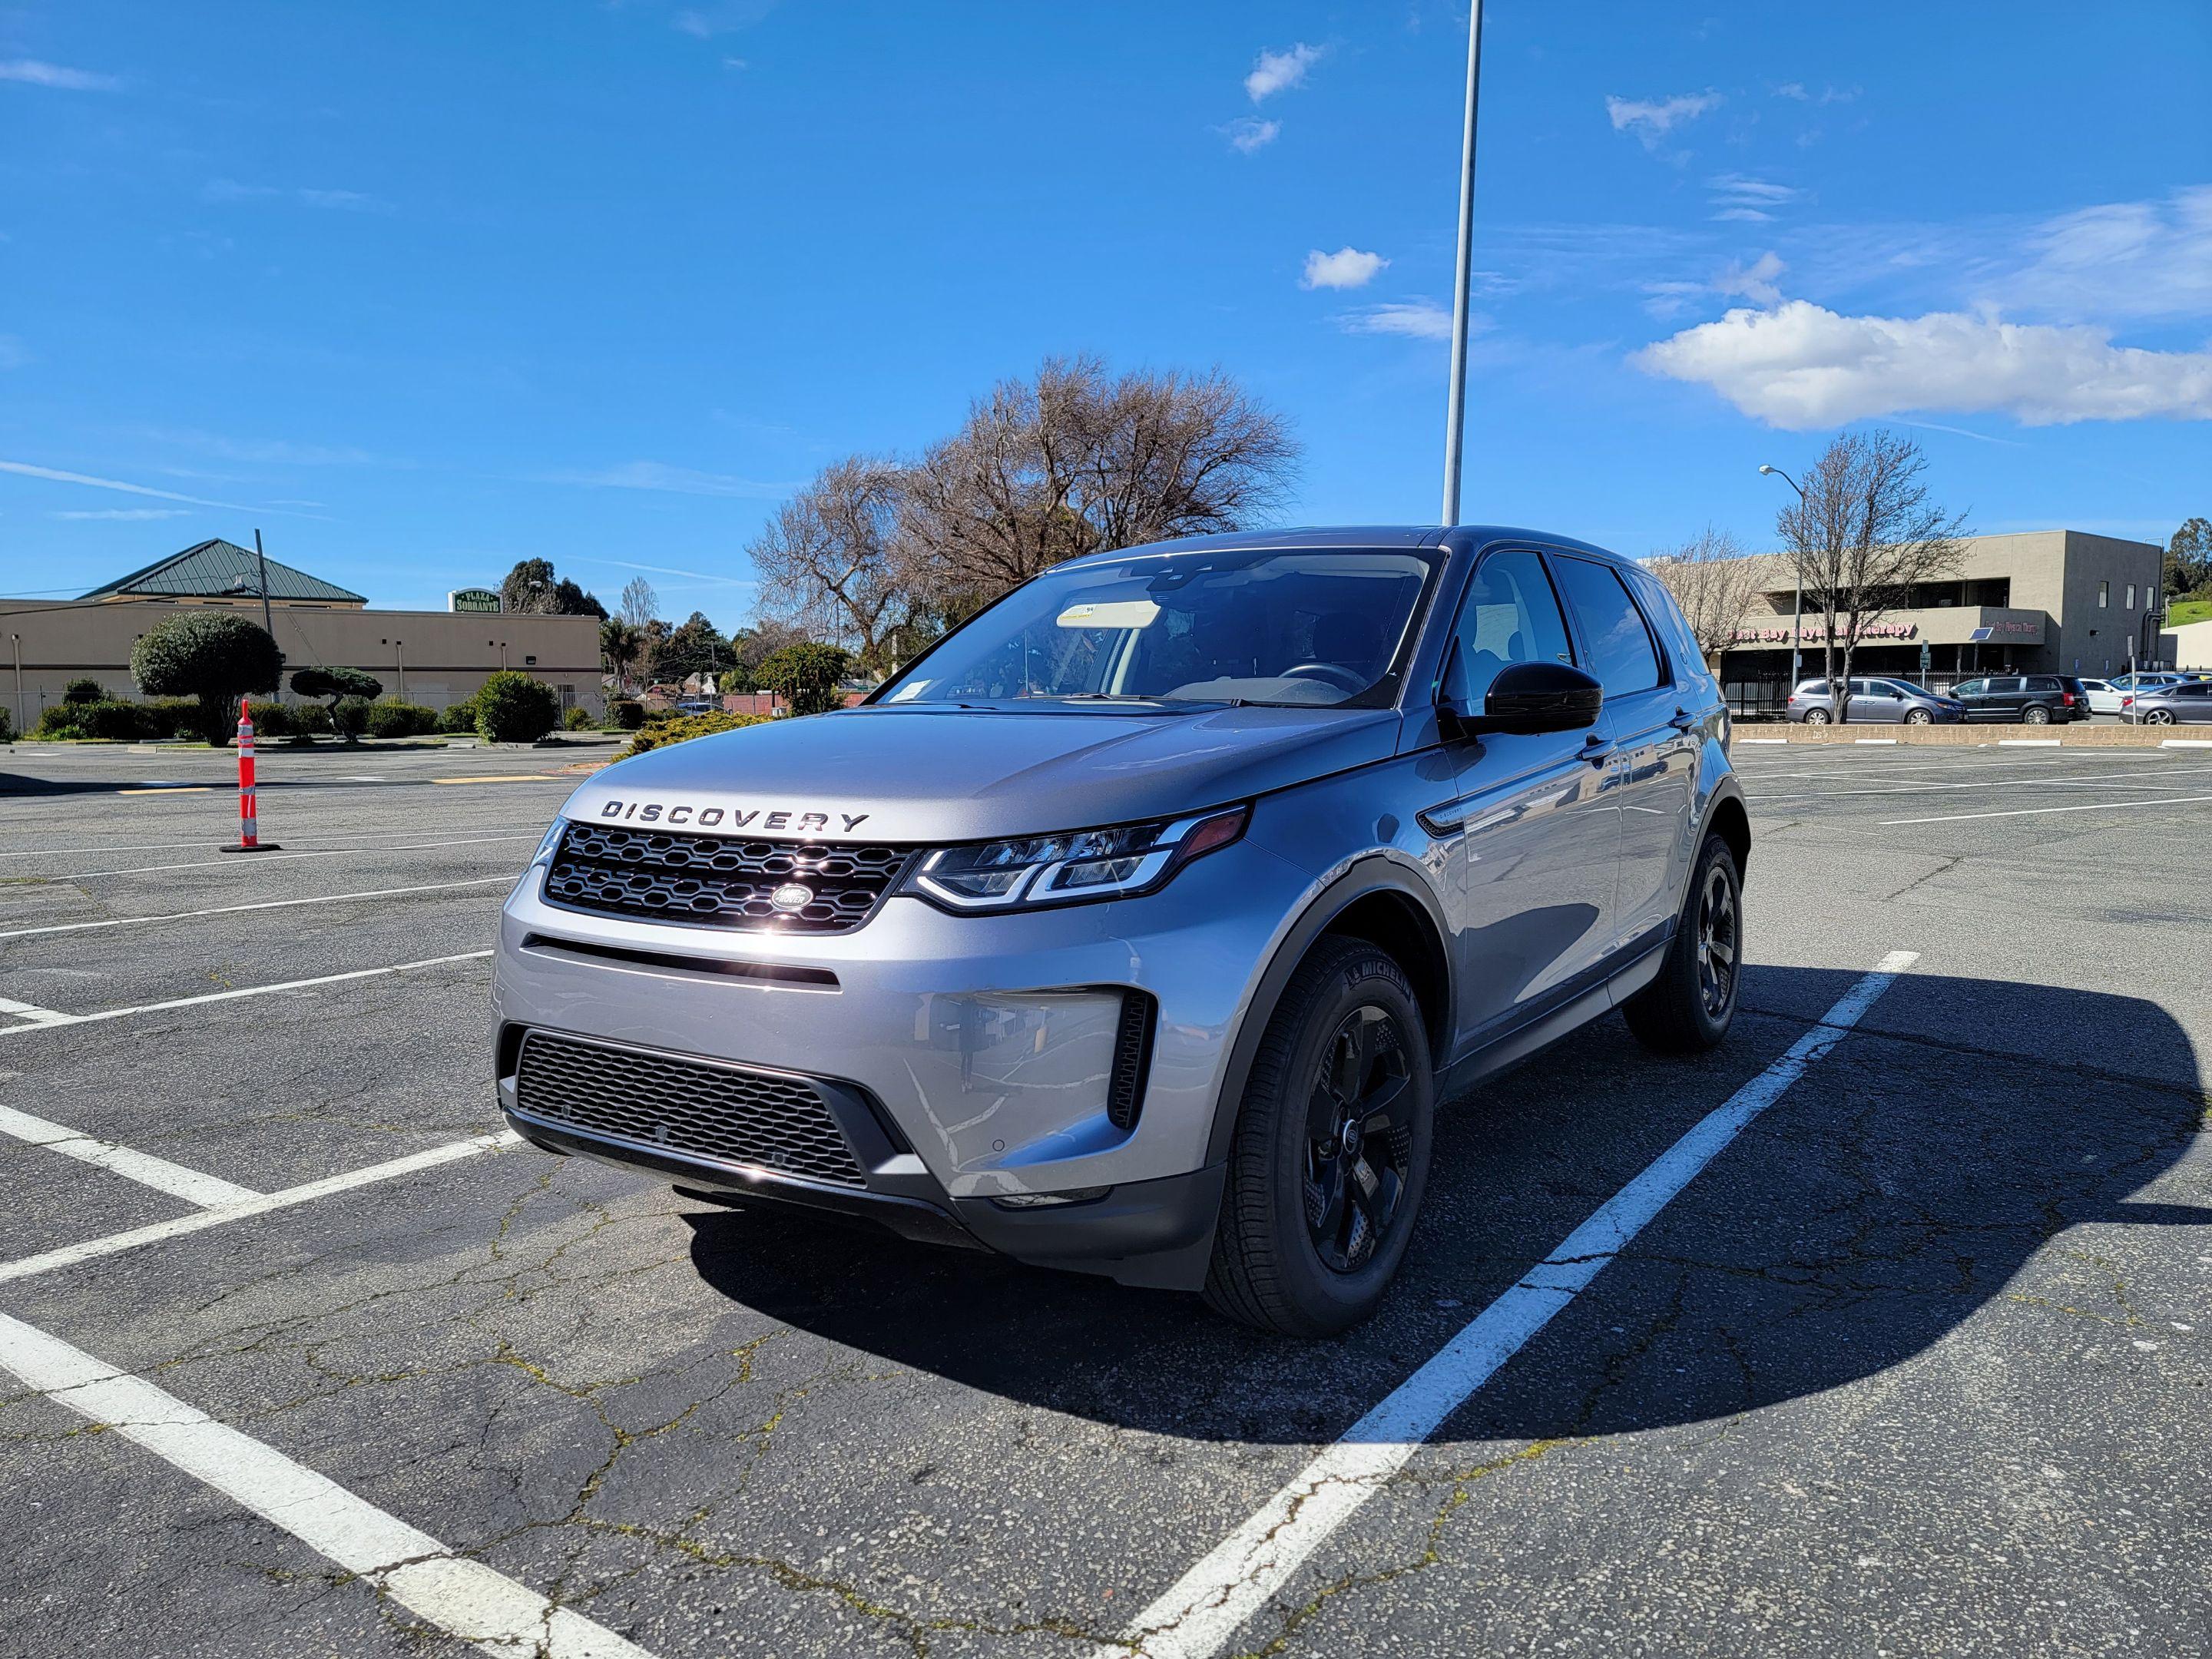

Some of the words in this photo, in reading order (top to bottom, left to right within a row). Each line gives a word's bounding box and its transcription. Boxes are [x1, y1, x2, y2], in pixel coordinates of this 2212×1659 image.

[465, 591, 490, 601] PLAZA
[456, 599, 499, 612] SOBRANTE
[1759, 628, 1786, 641] Bay
[601, 800, 870, 833] DISCOVERY
[778, 896, 806, 904] ROVER
[1362, 961, 1412, 996] MICHELIN
